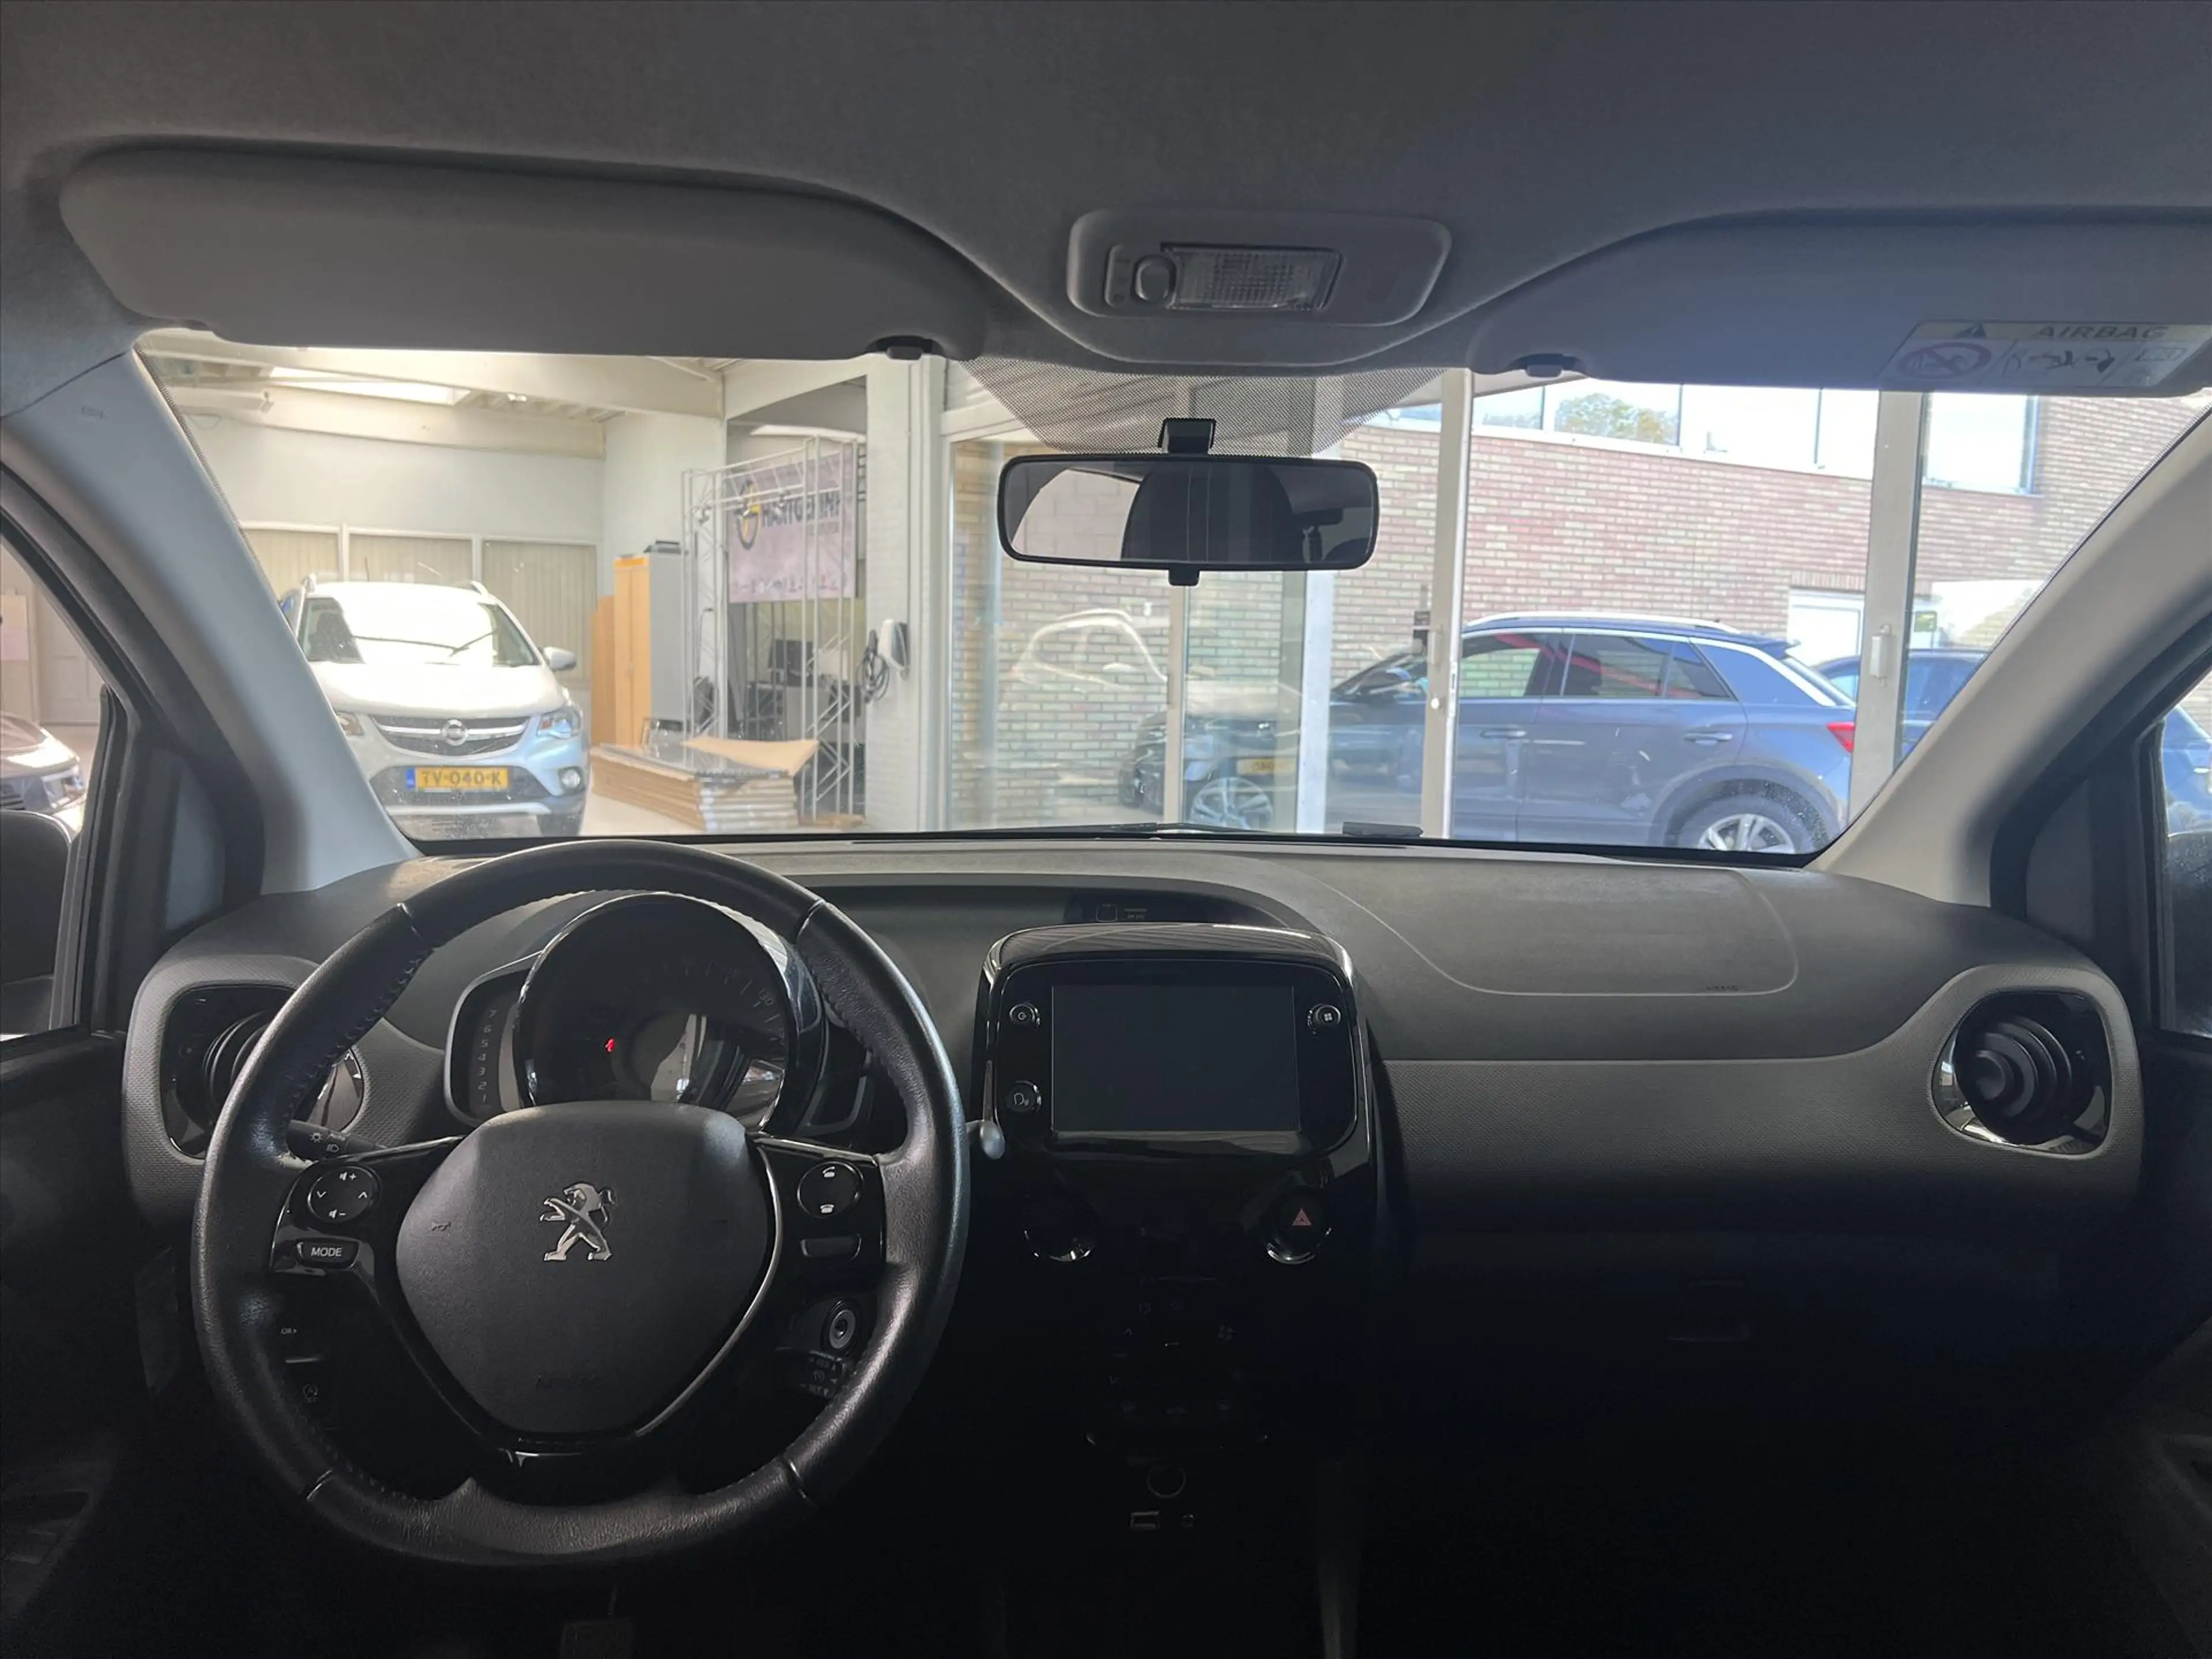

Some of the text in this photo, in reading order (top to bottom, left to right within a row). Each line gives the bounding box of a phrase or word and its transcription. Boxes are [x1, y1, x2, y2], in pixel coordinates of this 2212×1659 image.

[2038, 326, 2168, 339] AIRBAG
[481, 1039, 489, 1047] 5
[478, 1067, 486, 1076] 3
[478, 1081, 487, 1090] 2
[310, 1247, 342, 1257] MODE
